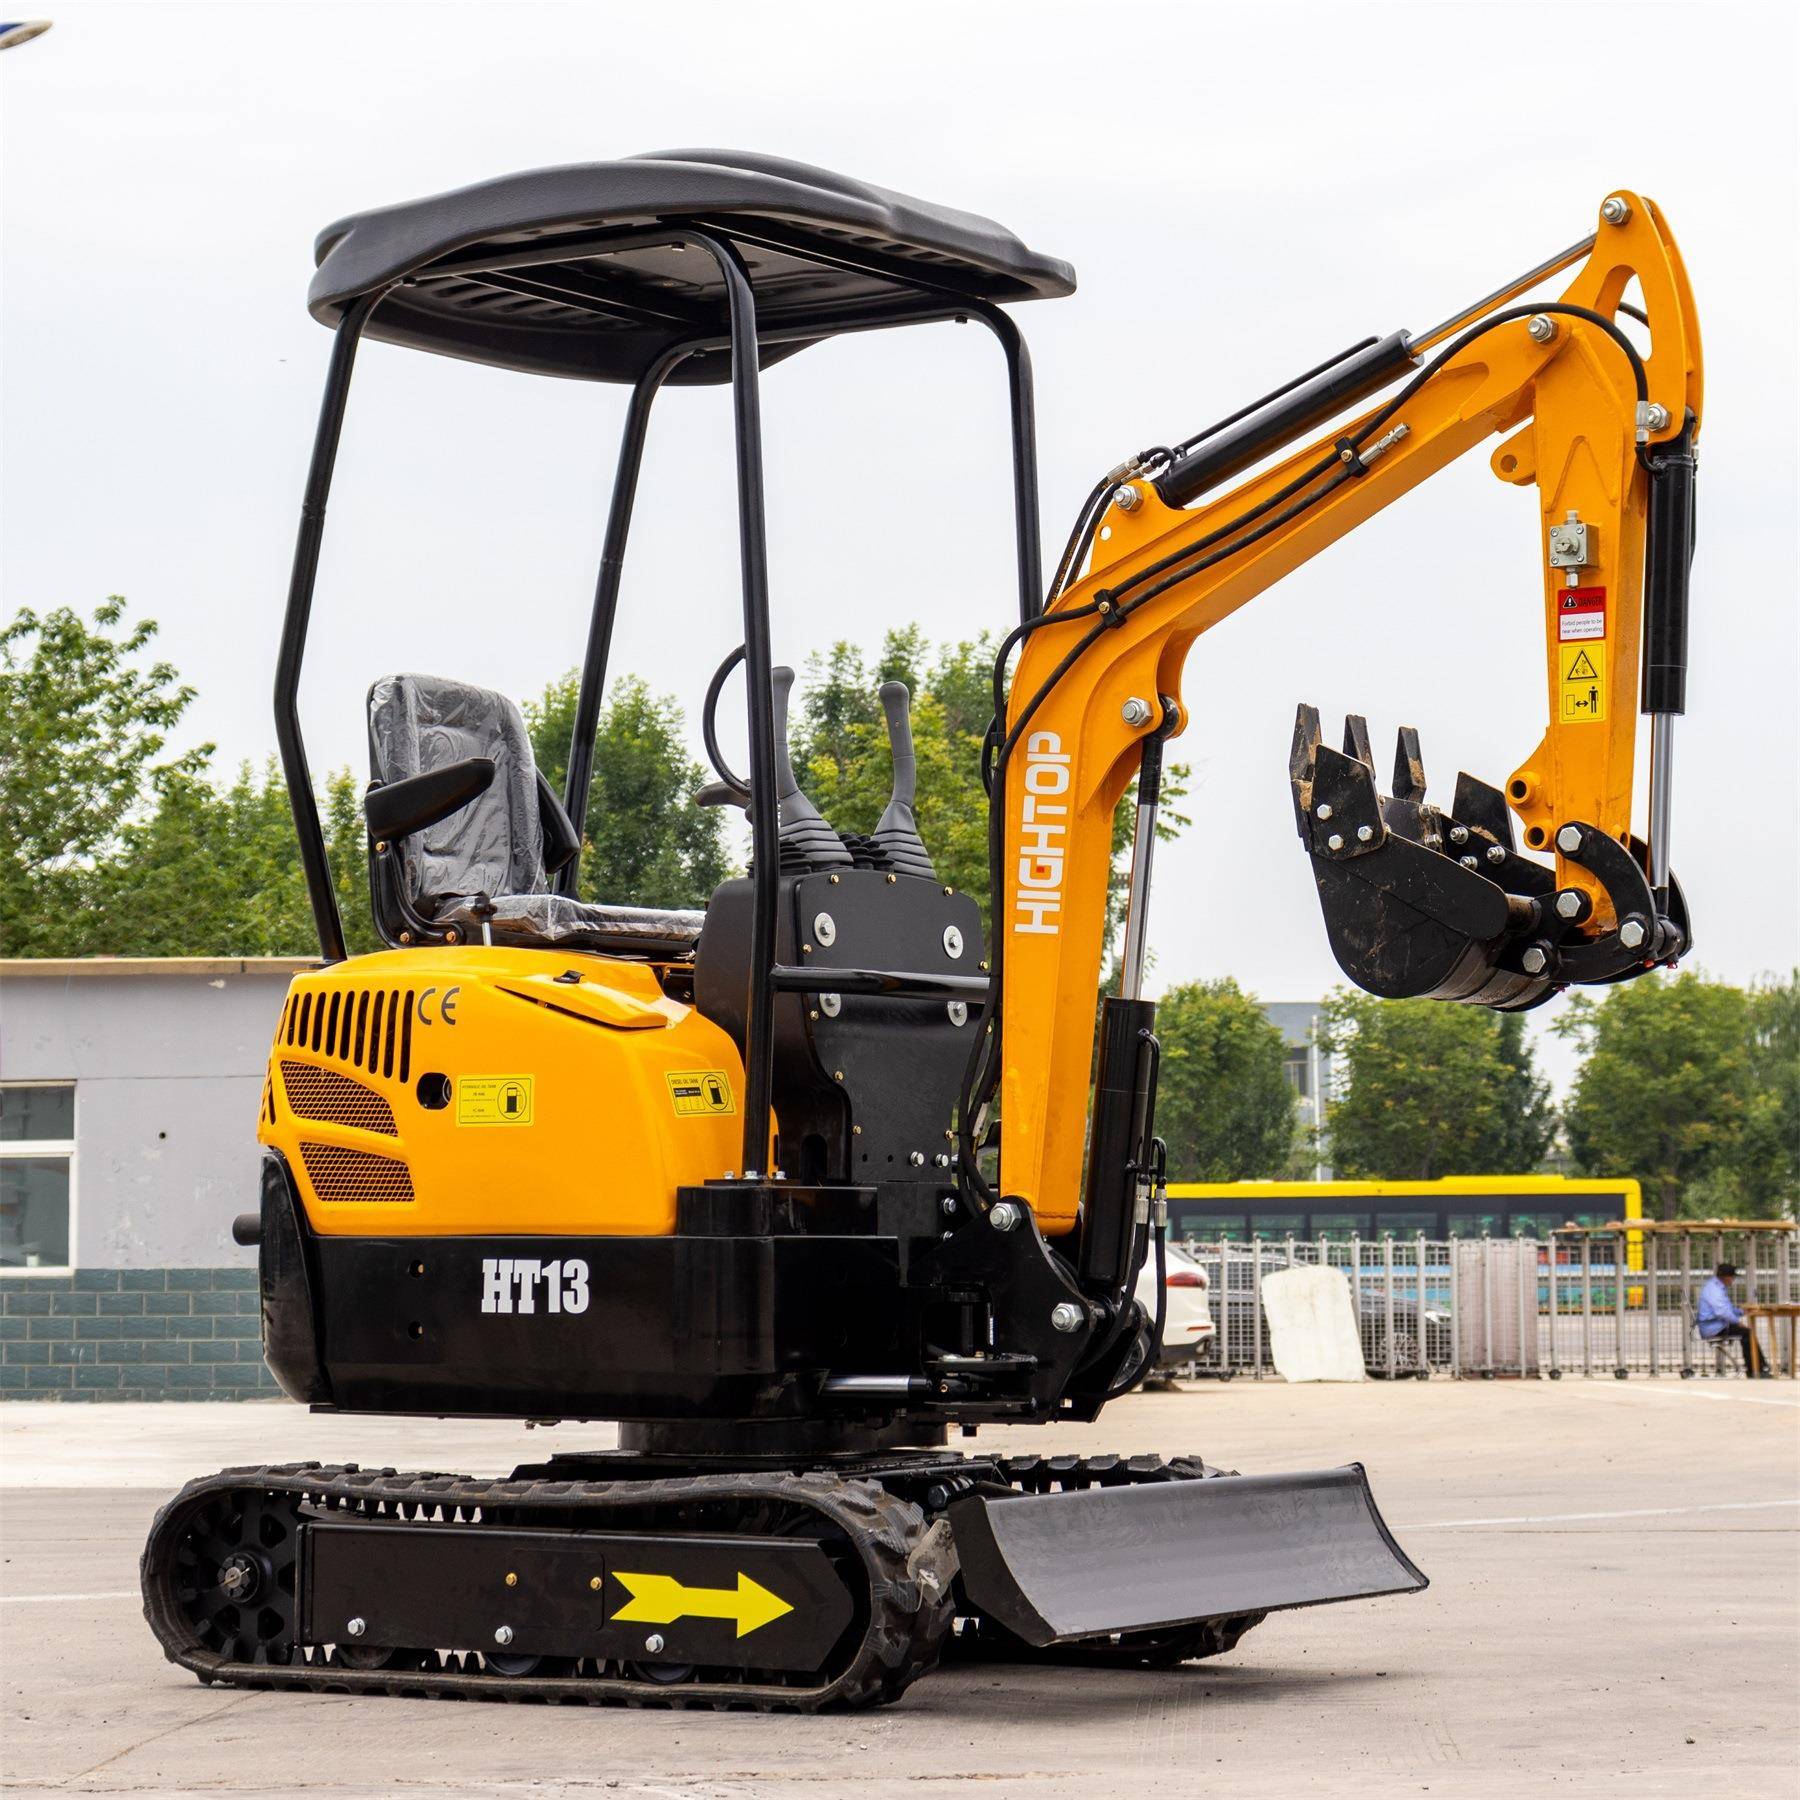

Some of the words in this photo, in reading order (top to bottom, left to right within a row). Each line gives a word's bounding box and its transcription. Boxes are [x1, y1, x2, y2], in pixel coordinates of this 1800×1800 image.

[1578, 595, 1603, 607] DANGER
[1014, 731, 1071, 934] HIGHTOP
[418, 987, 460, 1026] CE
[481, 1259, 589, 1314] HT13
